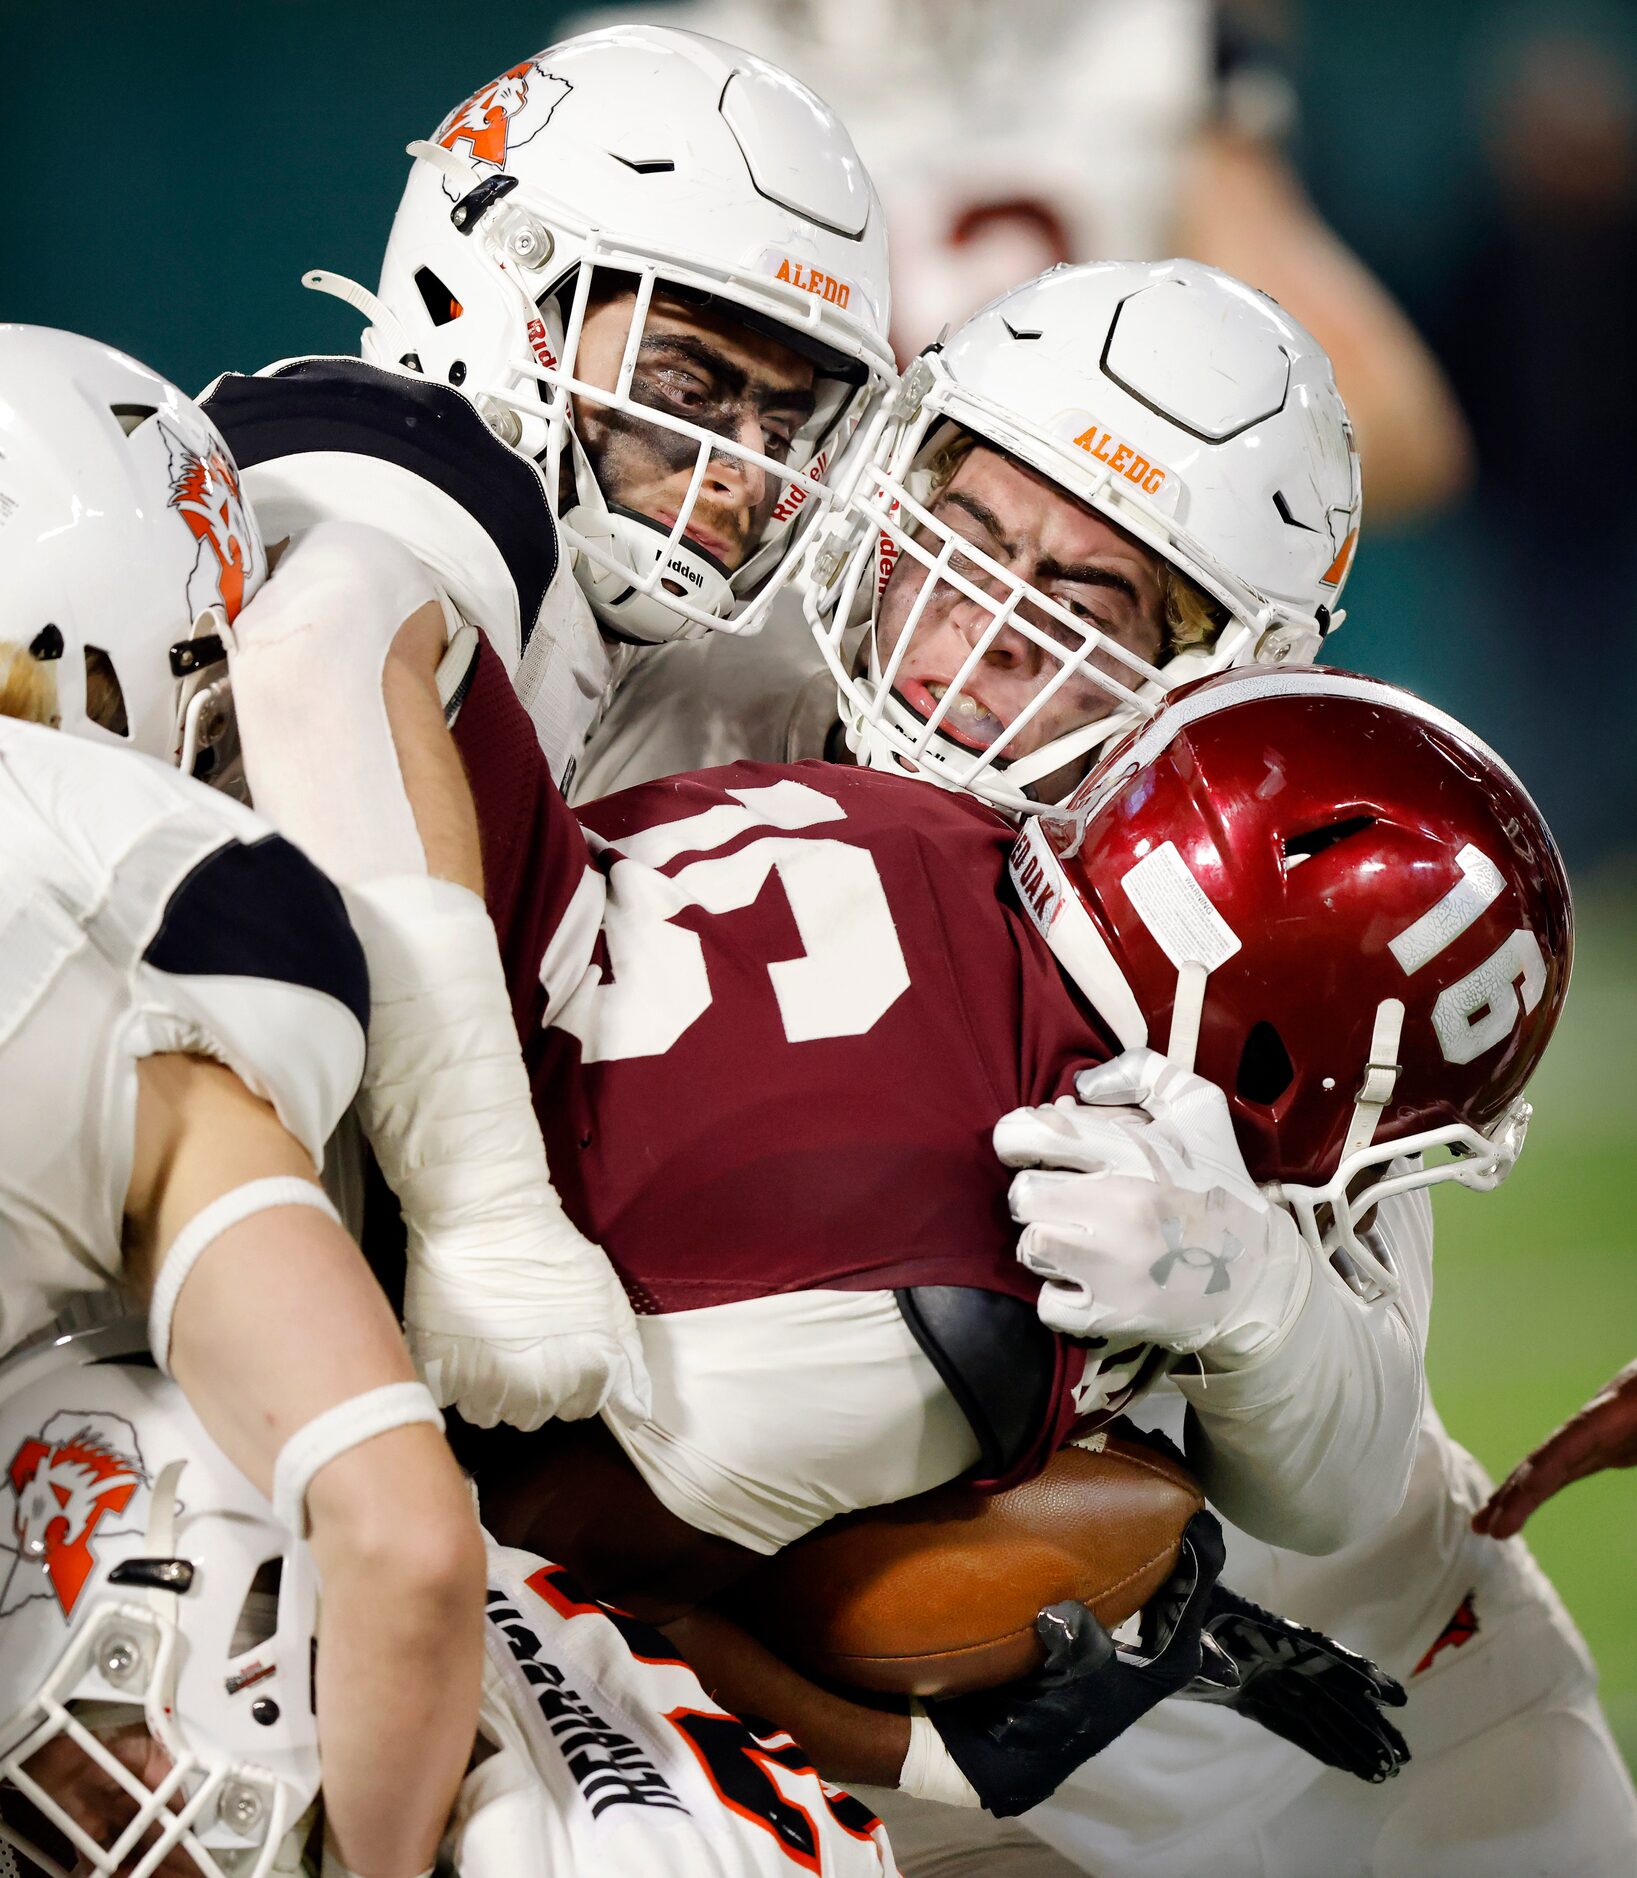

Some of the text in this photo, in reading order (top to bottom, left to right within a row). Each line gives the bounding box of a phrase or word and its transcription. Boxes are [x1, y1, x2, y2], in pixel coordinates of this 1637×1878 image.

[775, 258, 850, 310] ALEDO
[771, 452, 828, 522] Ridell
[1073, 426, 1166, 494] ALEDO
[539, 779, 911, 1064] 16
[1020, 855, 1056, 921] OAK
[1184, 876, 1214, 916] WARNING
[1387, 843, 1547, 1065] 16
